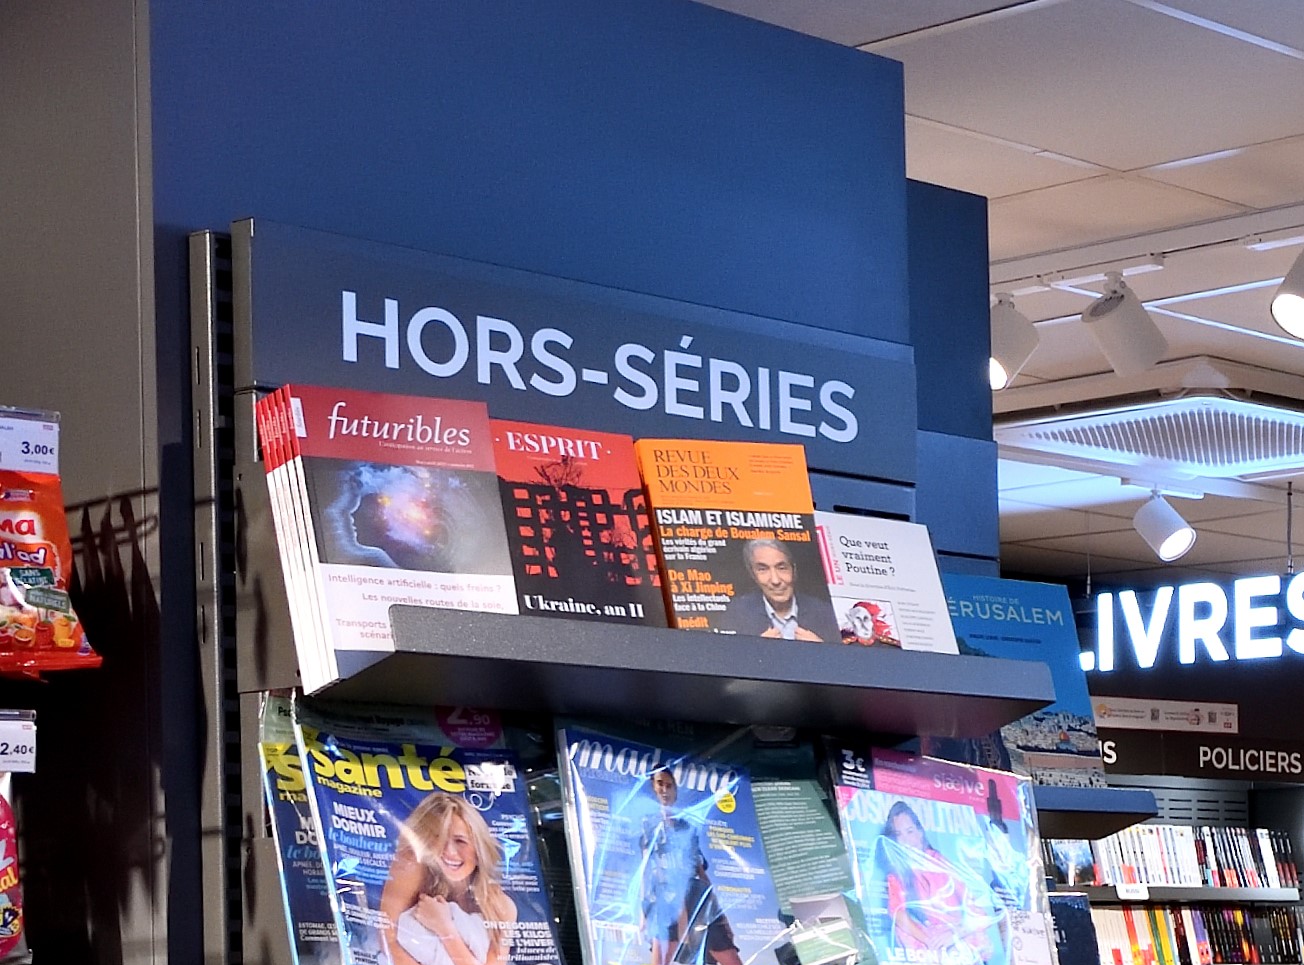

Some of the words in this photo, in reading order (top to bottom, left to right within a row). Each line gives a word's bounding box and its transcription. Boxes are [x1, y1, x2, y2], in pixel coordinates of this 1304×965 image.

[341, 290, 859, 444] HORS-SÉRIES
[328, 401, 471, 449] futuribles
[21, 441, 54, 456] 3,00€
[508, 432, 602, 461] ESPRIT
[653, 450, 712, 464] REVUE
[657, 465, 690, 478] DES
[694, 466, 740, 480] DEUX
[659, 480, 732, 494] MONDES
[657, 509, 702, 525] ISLAM
[706, 511, 722, 525] ET
[726, 512, 803, 529] ISLAMISME
[839, 535, 861, 550] Que
[864, 538, 889, 551] veut
[840, 550, 893, 564] vraiment
[668, 570, 684, 581] De
[687, 570, 711, 581] Mao
[524, 594, 590, 618] Ukraine,
[597, 602, 622, 617] an
[314, 746, 466, 792] santé
[1199, 745, 1302, 774] POLICIERS
[317, 775, 382, 799] magazine
[332, 802, 377, 824] MIEUX
[332, 814, 387, 839] DORMIR
